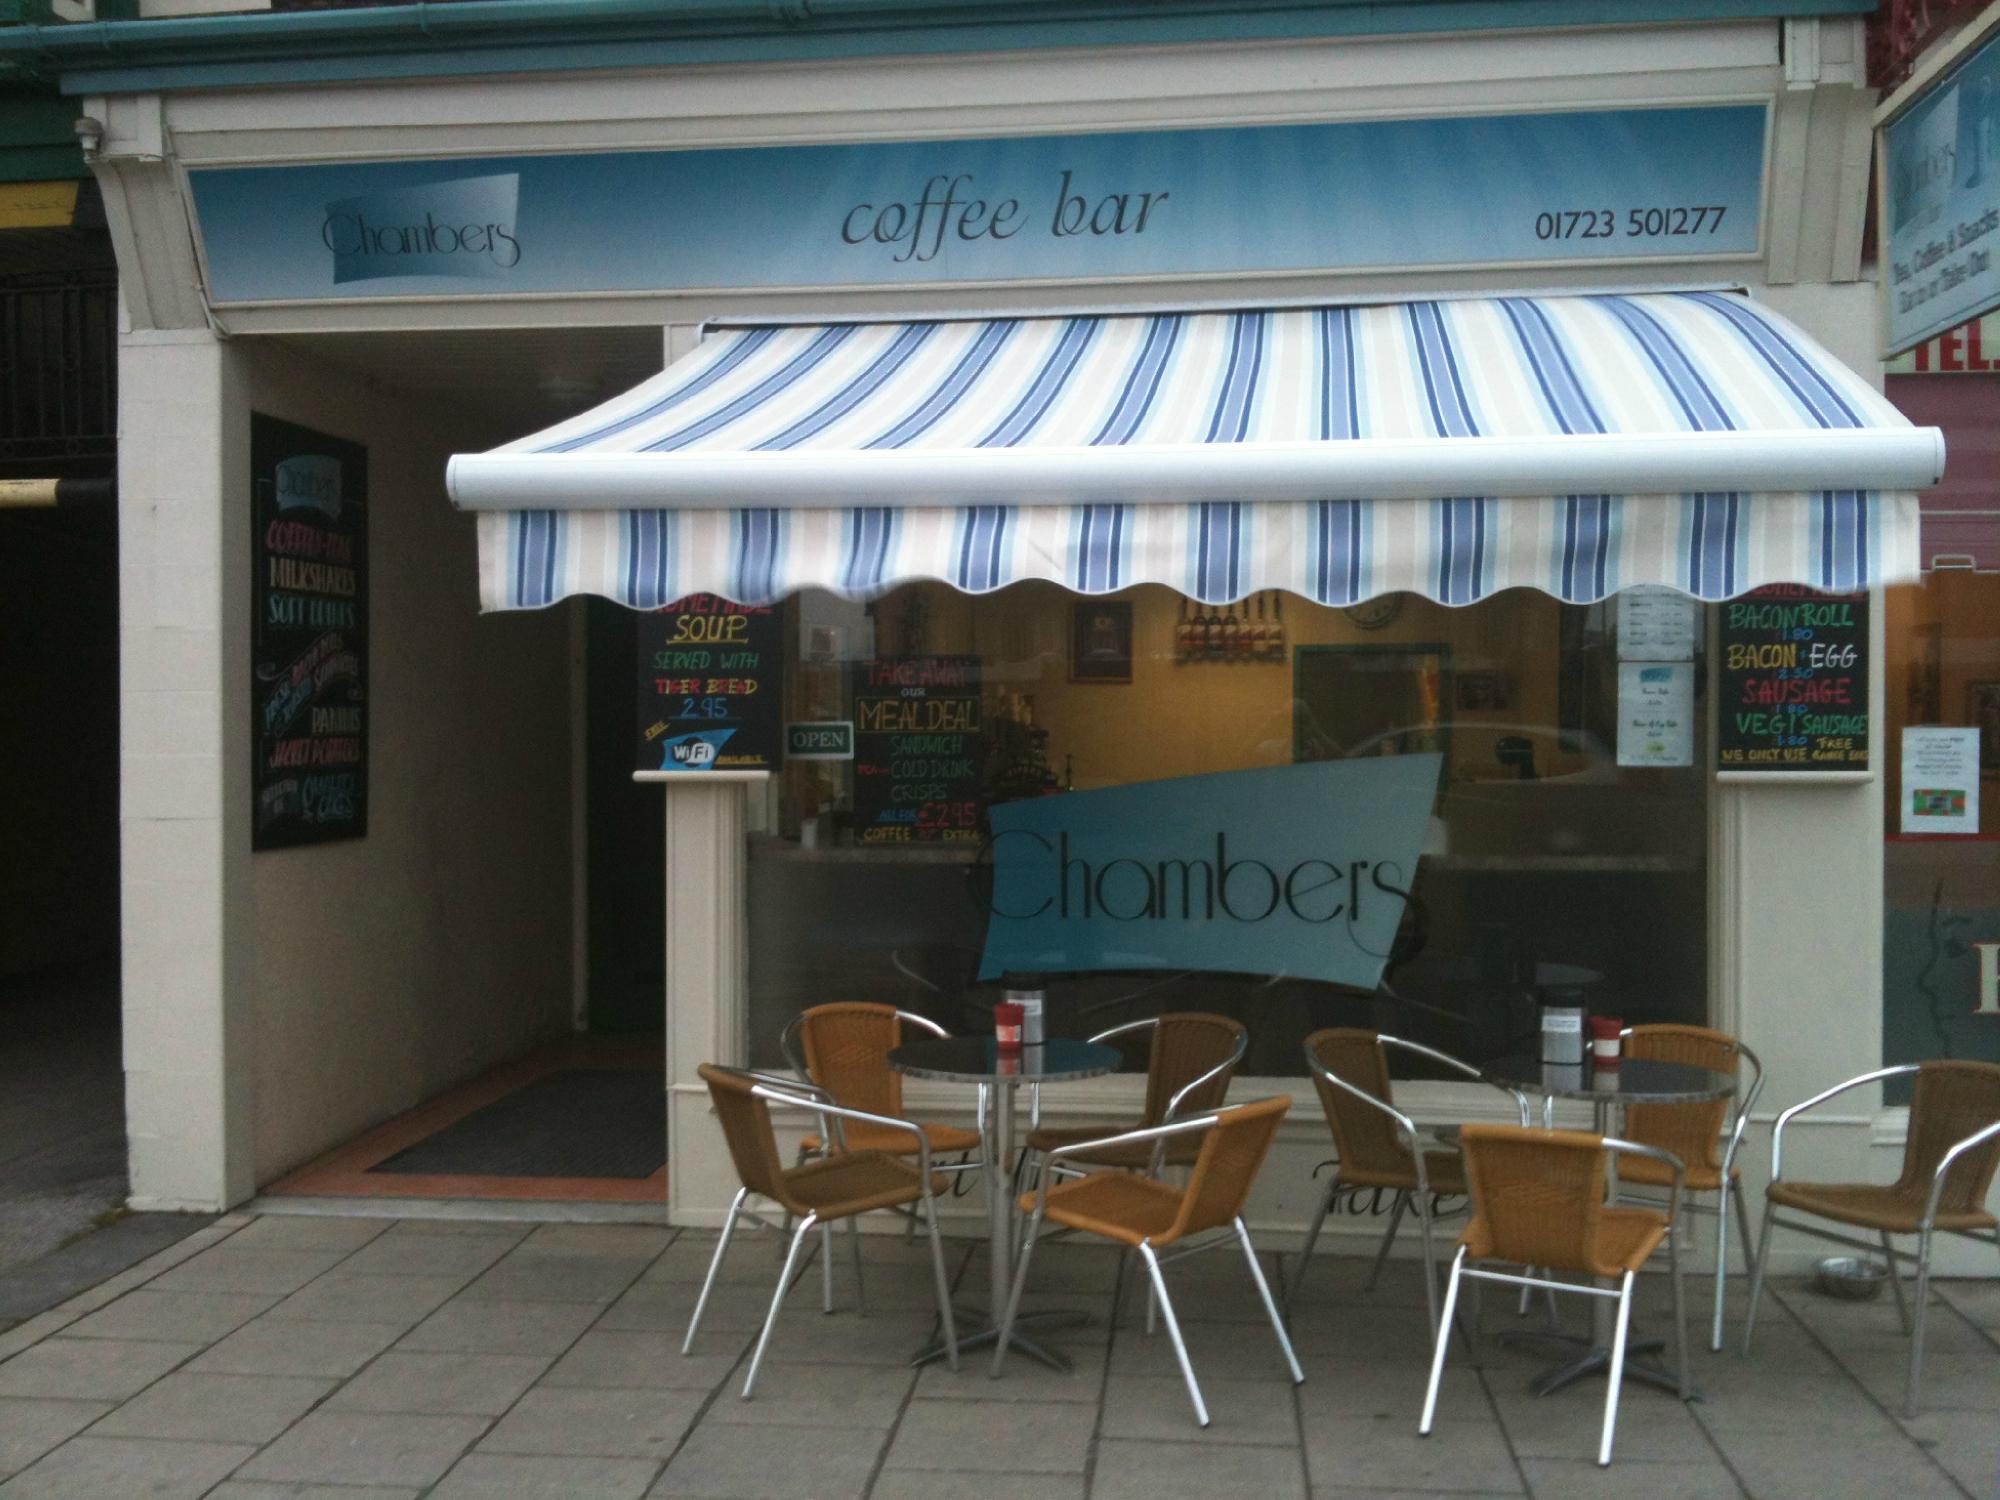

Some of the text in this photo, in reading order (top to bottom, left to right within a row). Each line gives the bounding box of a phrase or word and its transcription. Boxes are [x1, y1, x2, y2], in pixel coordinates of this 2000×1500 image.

[841, 170, 1170, 262] coffee bar
[1535, 206, 1727, 240] 01723 501277
[322, 211, 521, 268] Chambers
[1728, 603, 1855, 630] BACON ROLL
[673, 614, 747, 642] SOUP
[654, 652, 759, 669] SERVED WITH
[1727, 643, 1797, 669] BACON
[1808, 643, 1858, 669] EGG
[706, 679, 758, 695] BREAD
[900, 687, 927, 698] OUR
[1741, 677, 1854, 705] SAUSAGE
[859, 700, 980, 732] MEAL DEAL
[1802, 714, 1868, 736] SAUSAGE
[793, 731, 845, 747] OPEN
[889, 735, 963, 756] SANDWICH
[1816, 737, 1853, 750] FREE
[1722, 750, 1744, 761] WE
[1748, 749, 1780, 761] ONLY
[1783, 748, 1808, 761] USE
[890, 760, 928, 780] COLD
[930, 759, 976, 779] DRINK
[890, 784, 948, 801] CRISPS
[863, 827, 912, 842] COFFEE
[976, 829, 1428, 962] Chambers
